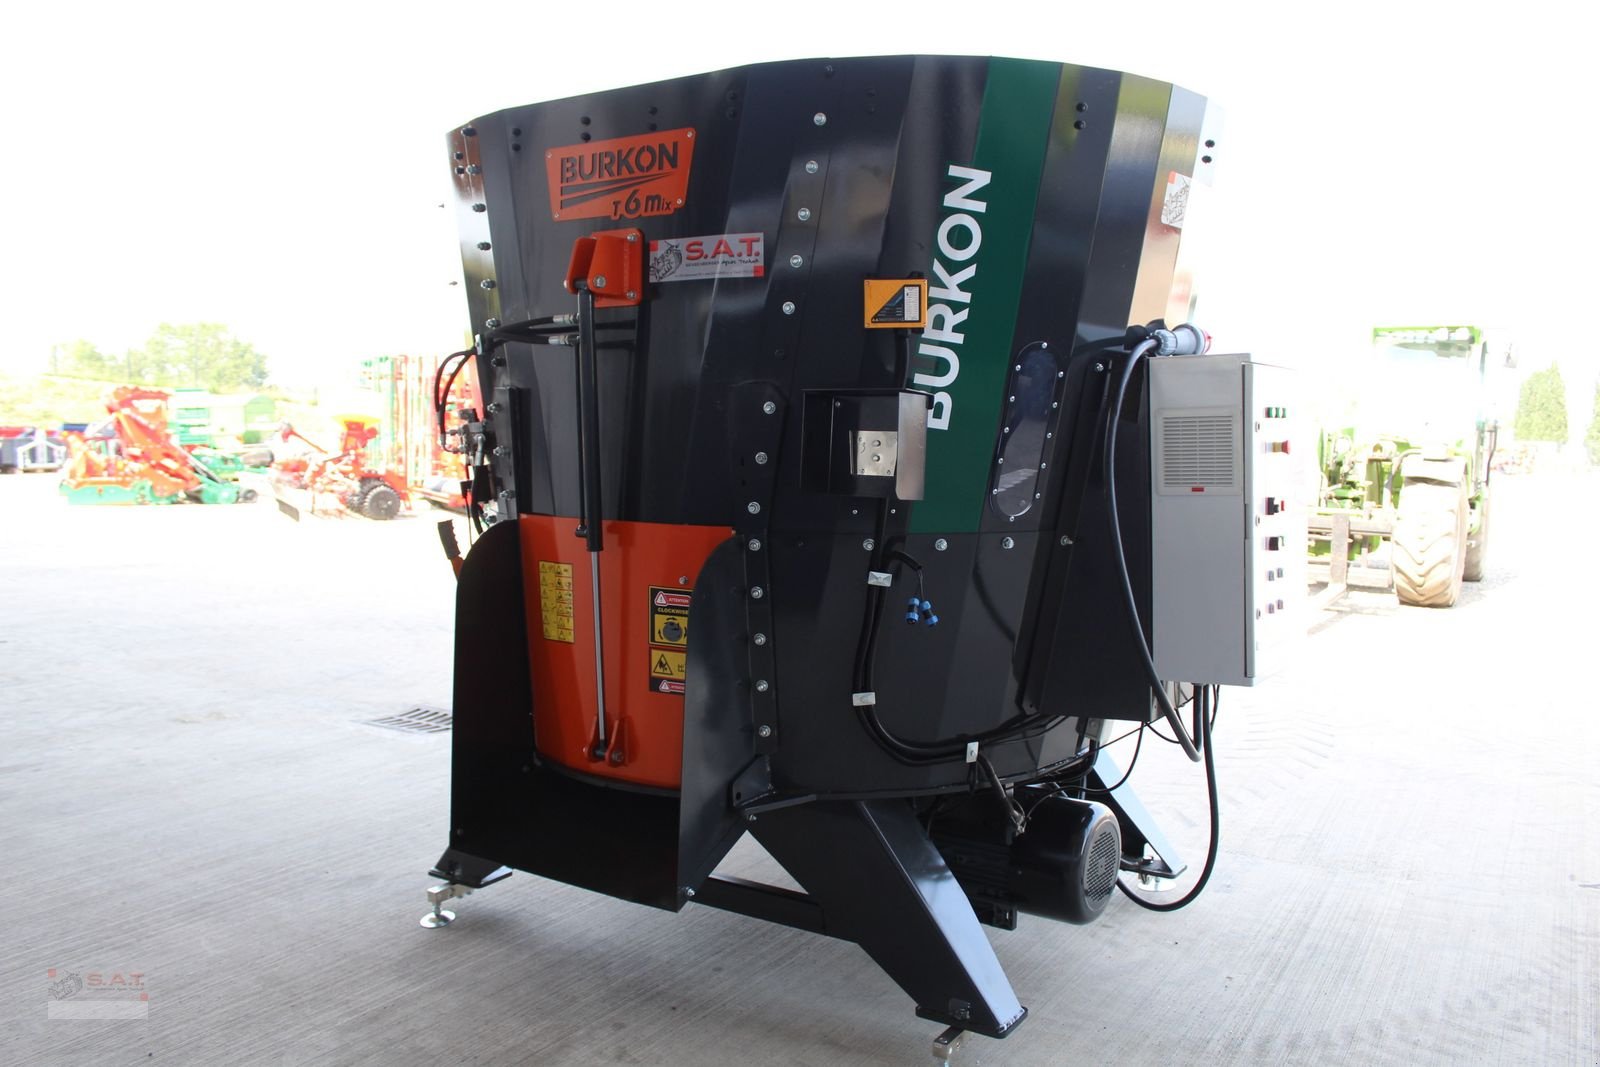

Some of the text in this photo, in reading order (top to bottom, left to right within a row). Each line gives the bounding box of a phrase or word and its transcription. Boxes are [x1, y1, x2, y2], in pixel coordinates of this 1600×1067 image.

[560, 141, 679, 184] BURKON
[685, 236, 761, 261] S.A.T.
[913, 164, 993, 431] BURKON
